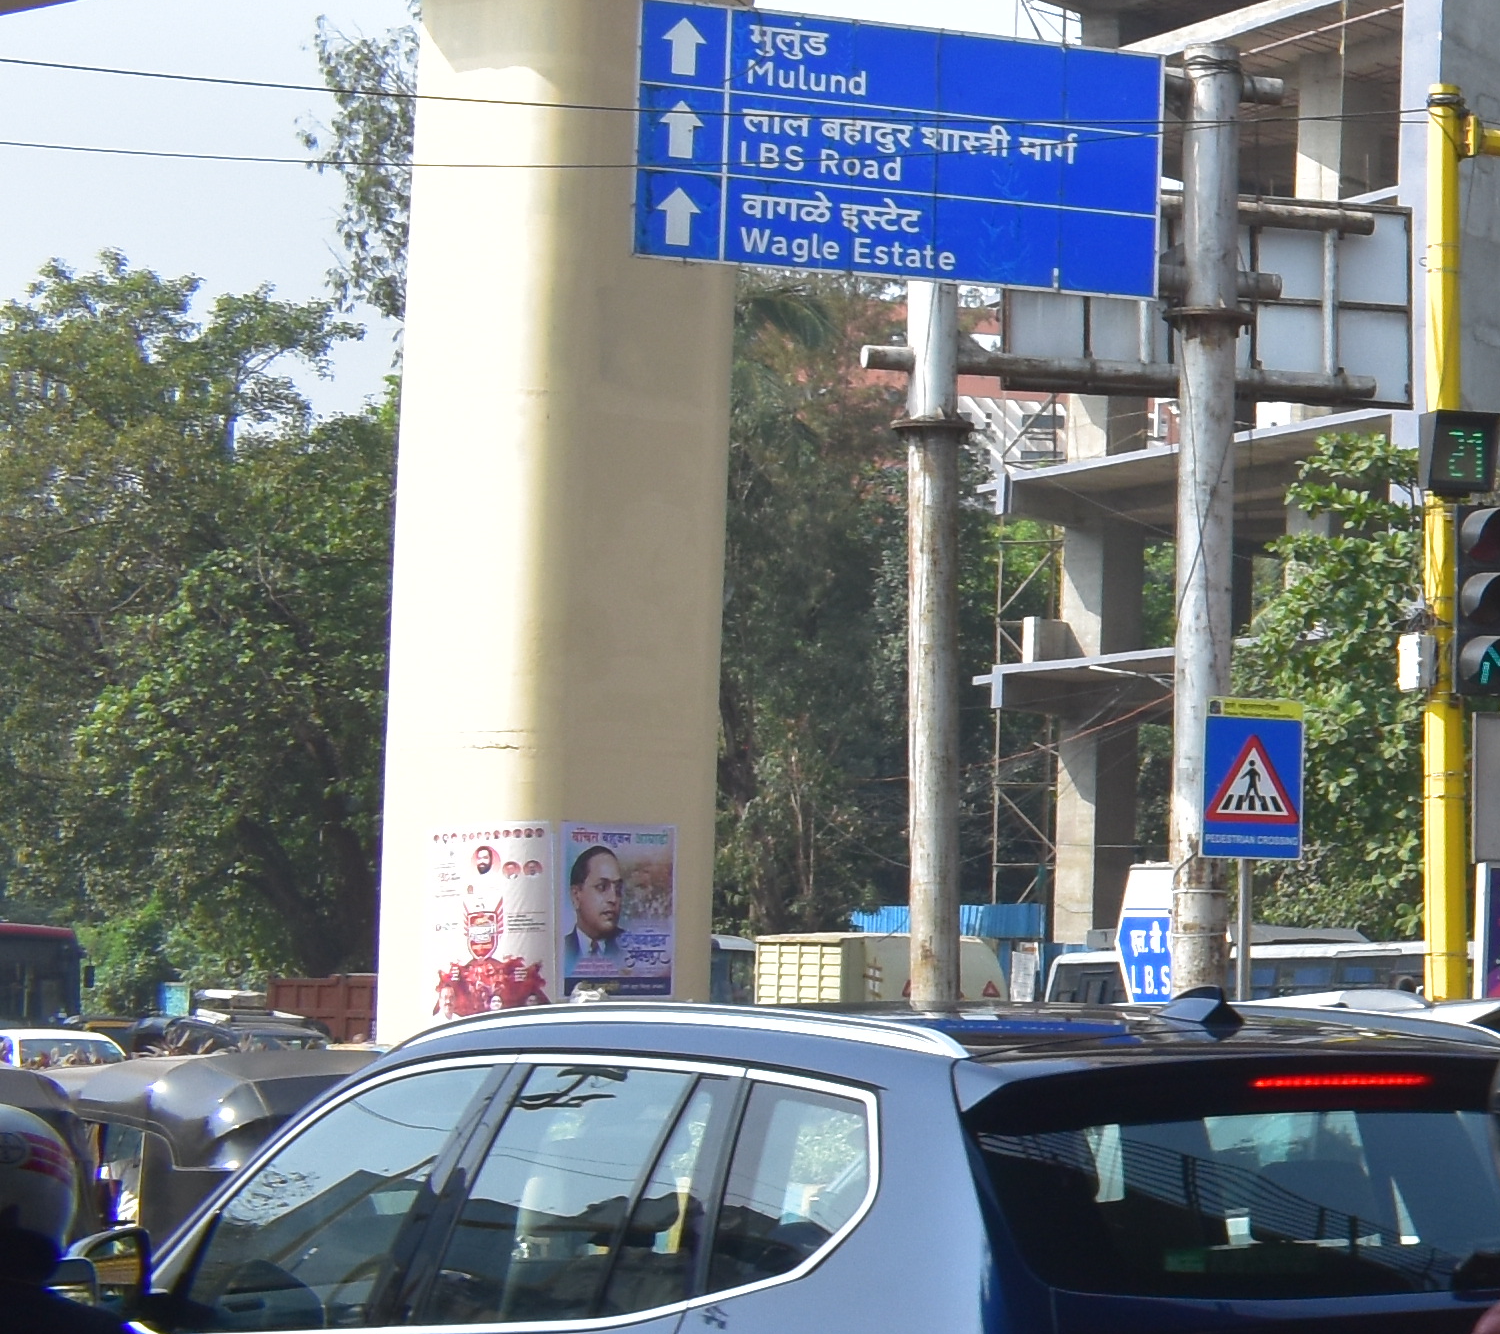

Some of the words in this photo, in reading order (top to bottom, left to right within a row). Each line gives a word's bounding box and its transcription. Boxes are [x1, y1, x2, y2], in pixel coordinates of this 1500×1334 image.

[749, 21, 829, 59] मुलुंड
[747, 59, 867, 96] Mulund
[741, 108, 811, 137] लाल
[820, 117, 913, 153] बहादुर
[921, 125, 1011, 157] शास्त्री
[1019, 133, 1078, 164] मार्ग
[741, 141, 805, 171] LBS
[820, 148, 902, 181] Road
[741, 191, 832, 223] वागळे
[841, 197, 921, 233] इस्टेट
[741, 226, 840, 262] Wagle
[854, 237, 956, 271] Estate
[1205, 833, 1255, 844] PEDESTRIAN
[1257, 835, 1298, 846] CROSSING
